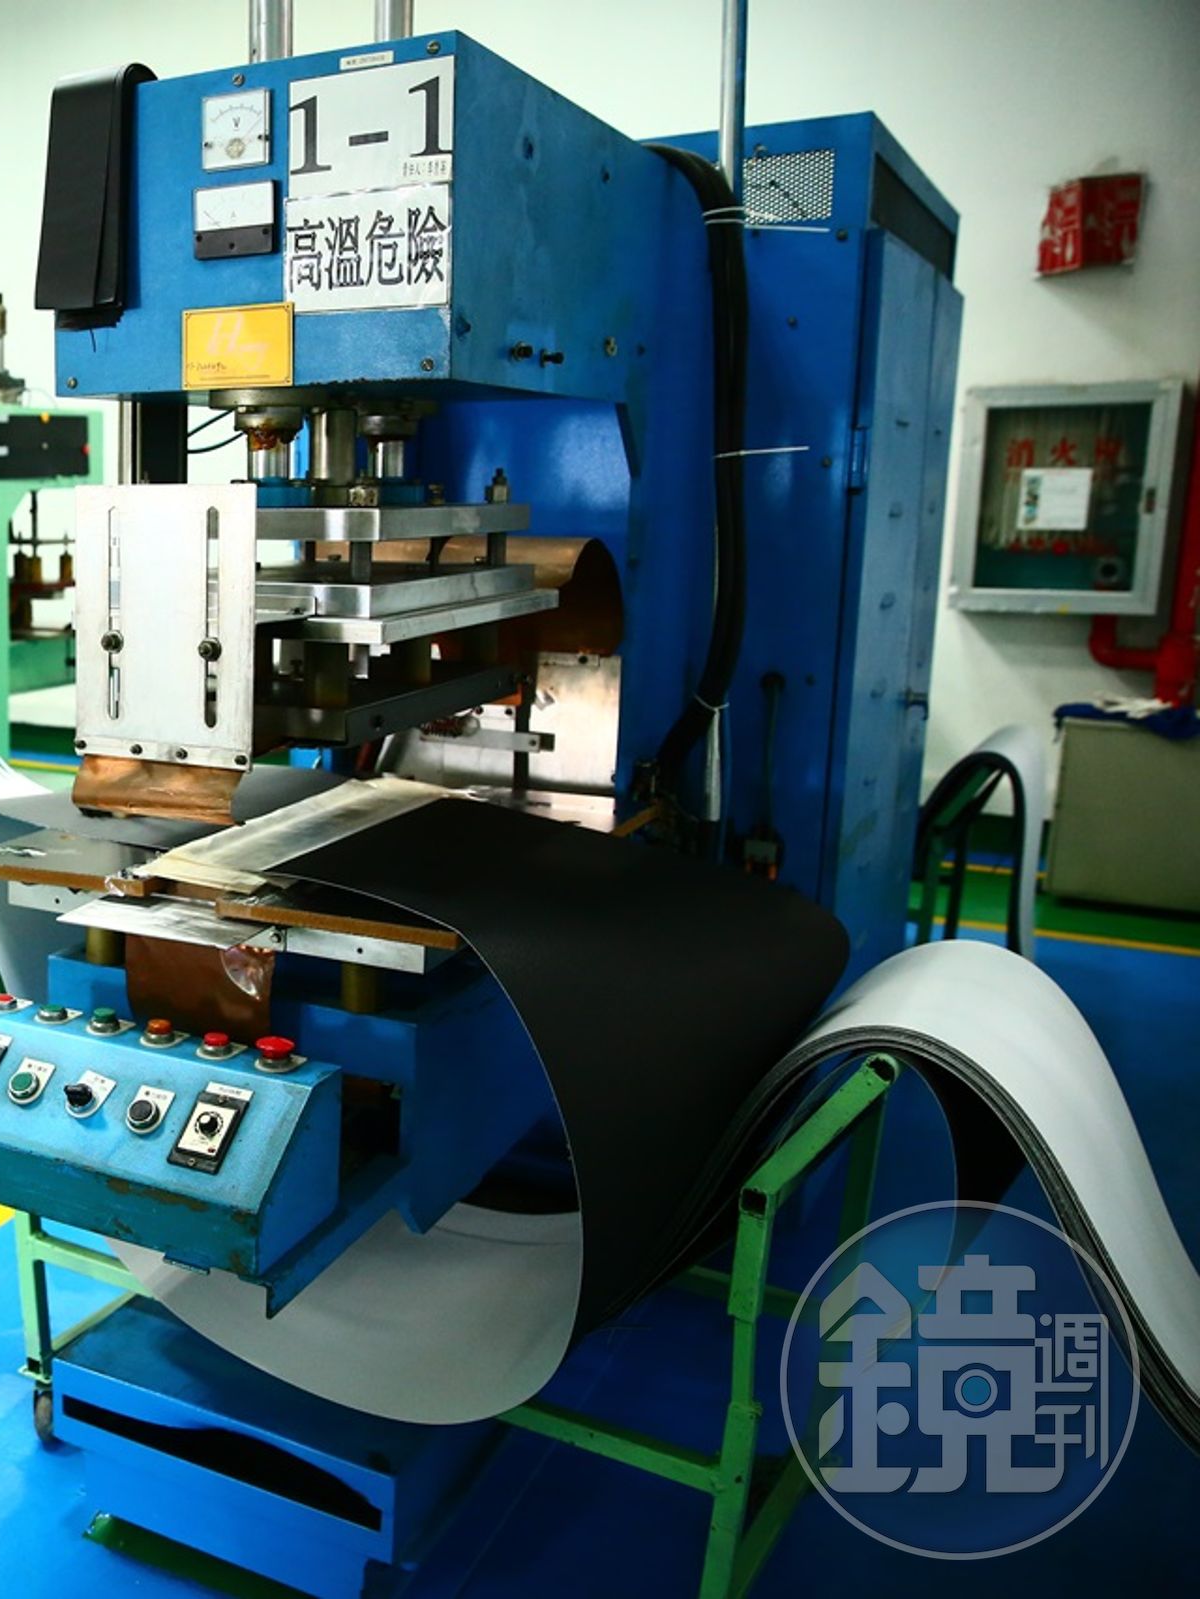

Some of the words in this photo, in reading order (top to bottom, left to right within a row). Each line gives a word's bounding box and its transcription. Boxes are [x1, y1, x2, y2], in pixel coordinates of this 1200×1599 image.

[289, 76, 452, 175] 1-1
[286, 205, 448, 292] 高溫危險
